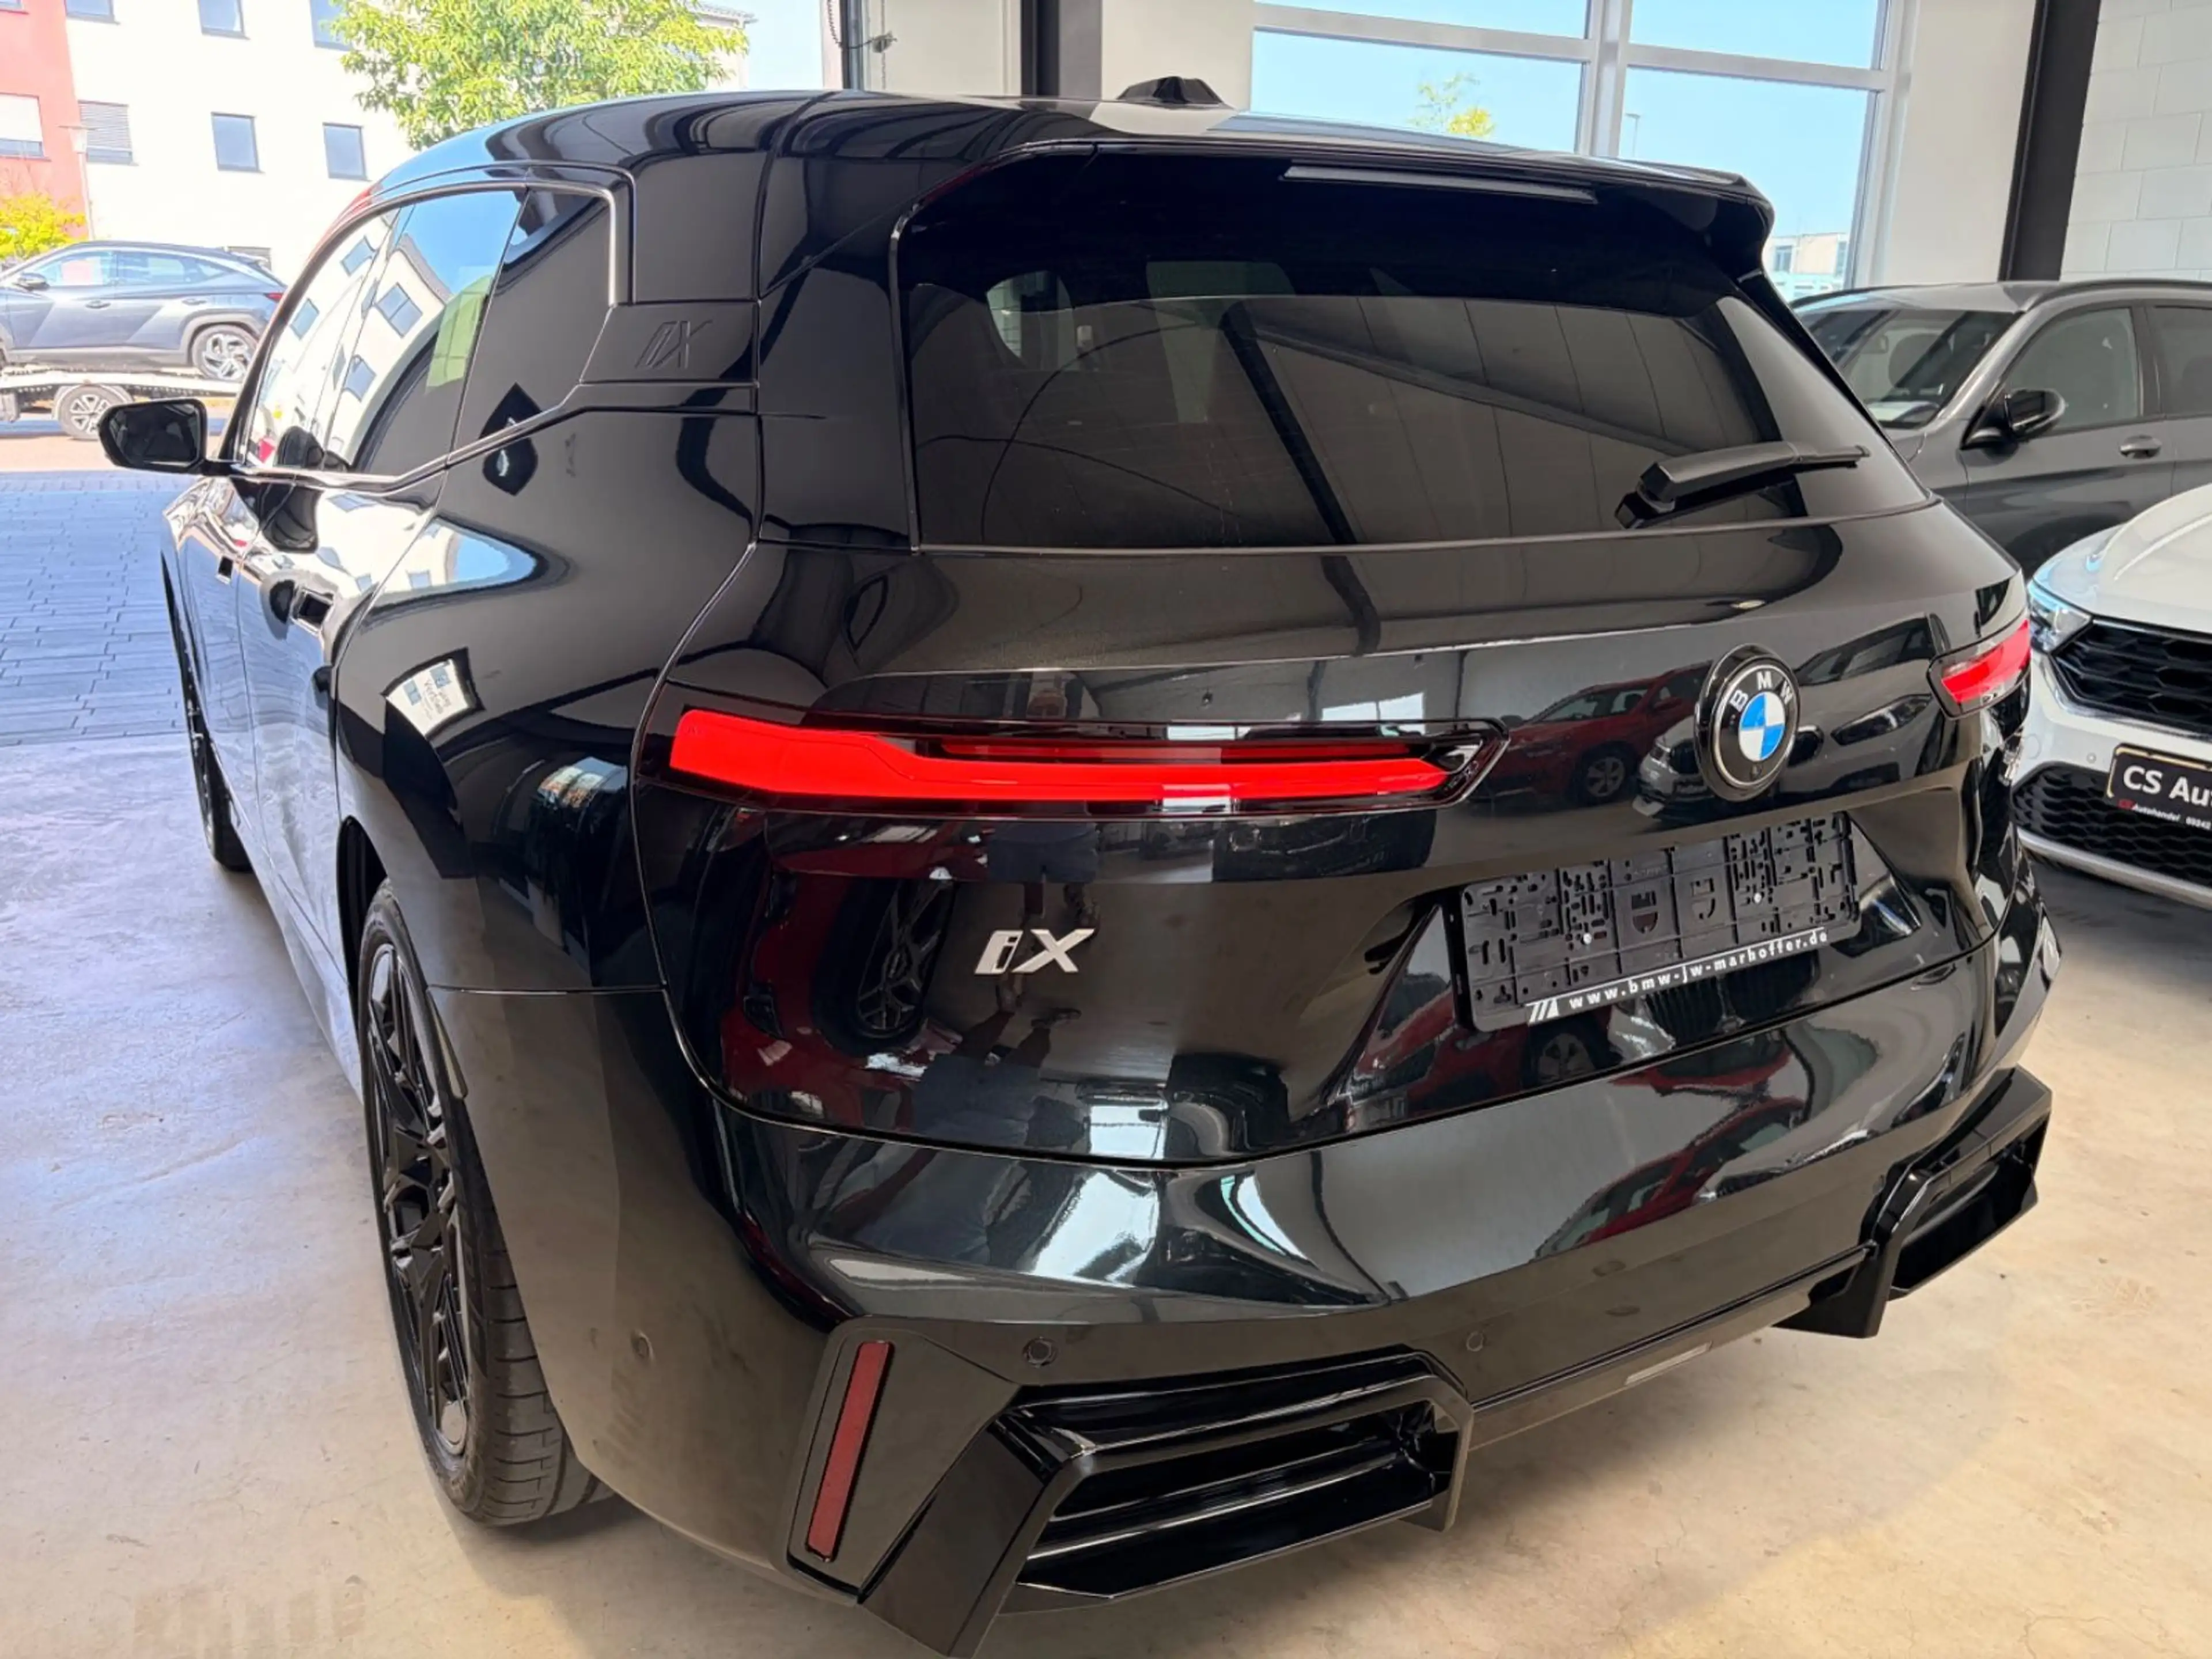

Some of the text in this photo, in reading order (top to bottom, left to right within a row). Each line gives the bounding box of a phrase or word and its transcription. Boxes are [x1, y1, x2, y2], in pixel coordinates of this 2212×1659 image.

[1729, 671, 1793, 712] BMW
[2123, 765, 2212, 806] CS Au
[974, 929, 1095, 974] iX
